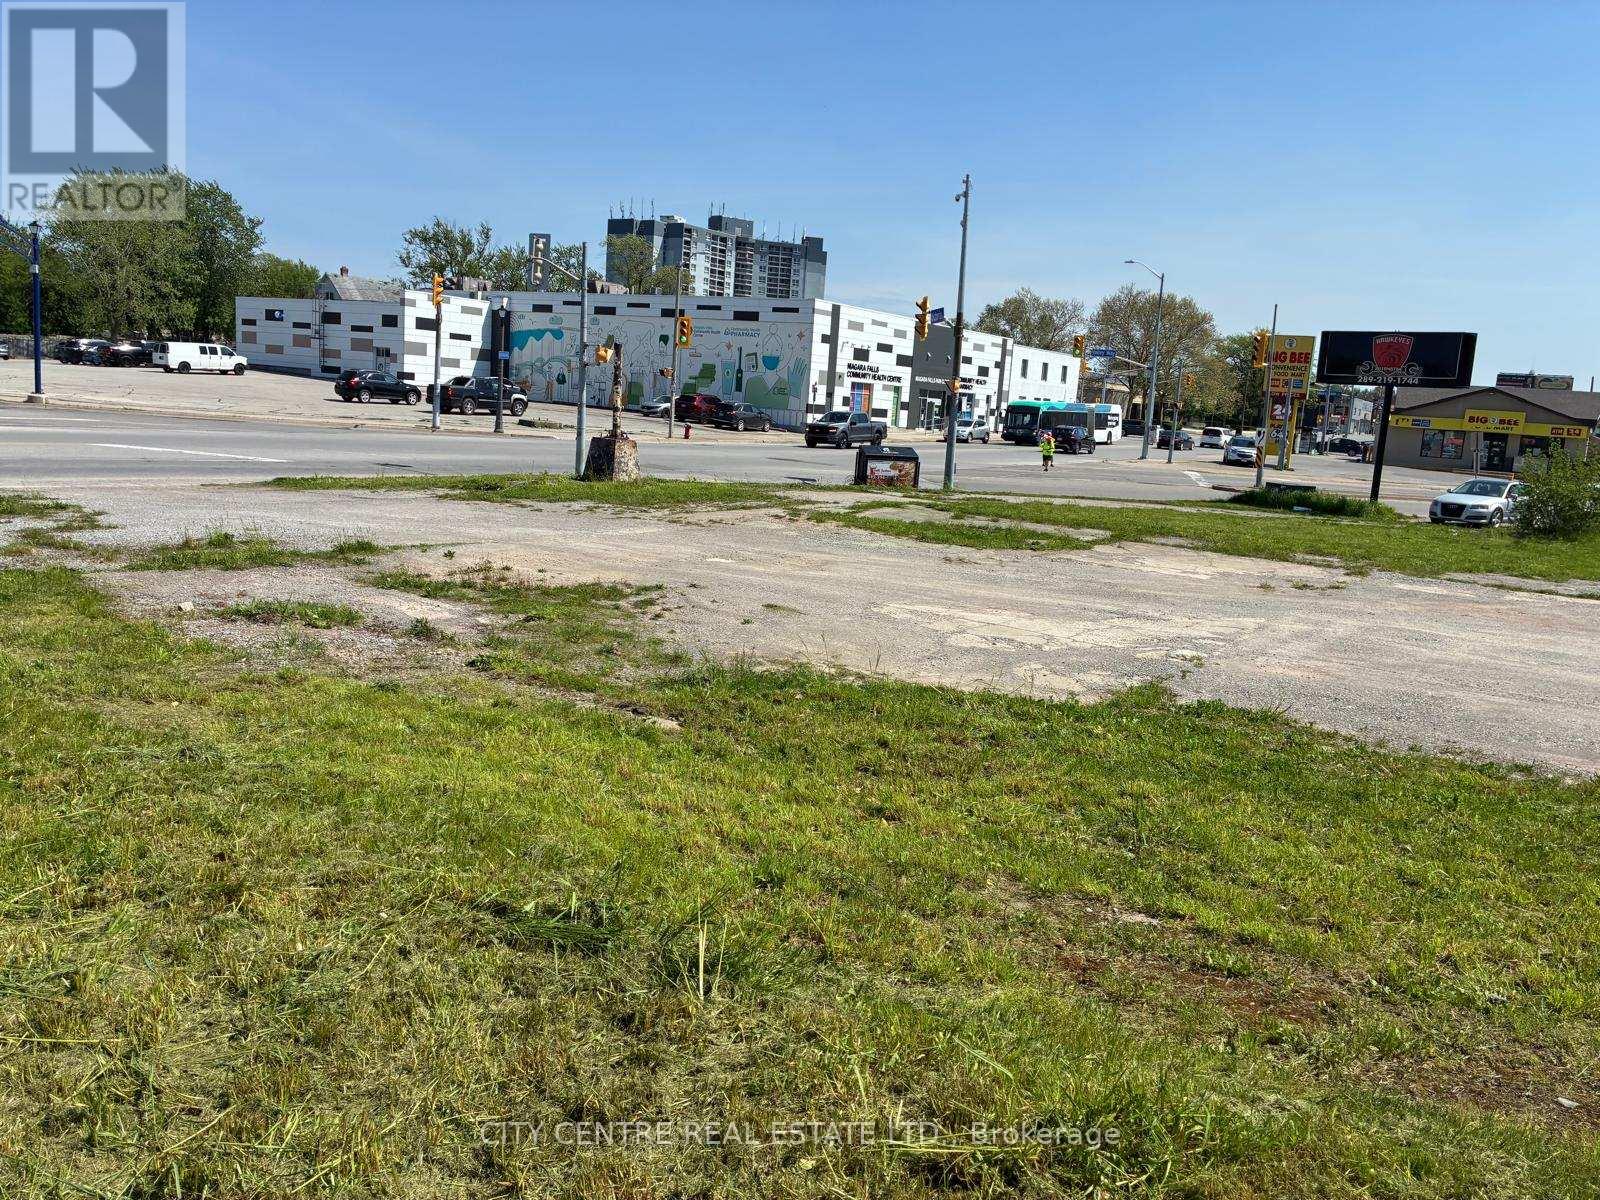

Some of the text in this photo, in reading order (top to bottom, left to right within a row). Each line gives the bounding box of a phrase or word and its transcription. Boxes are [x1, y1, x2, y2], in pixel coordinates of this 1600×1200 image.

[1289, 351, 1311, 364] BEE
[847, 362, 880, 373] NIAGARA FALLS
[846, 370, 871, 379] COMMUNITY
[871, 373, 887, 381] HEALTH
[1357, 375, 1419, 384] 289-219-1744
[1468, 415, 1519, 426] BIG BEE
